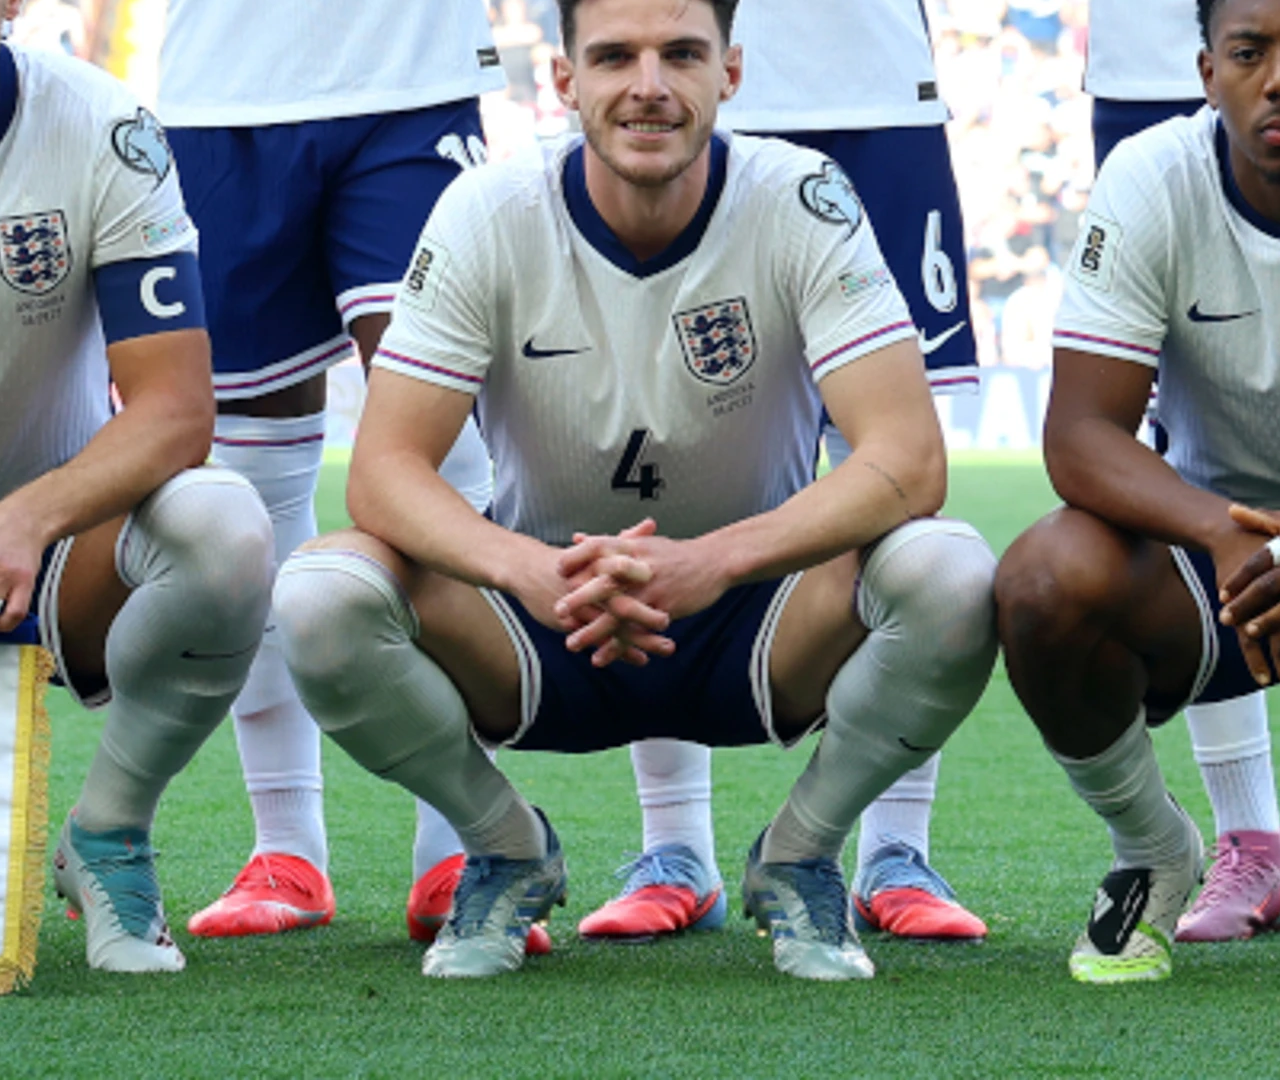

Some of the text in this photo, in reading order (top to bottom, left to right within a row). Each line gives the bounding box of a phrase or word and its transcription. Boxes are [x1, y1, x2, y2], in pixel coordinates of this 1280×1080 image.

[139, 266, 186, 319] C
[922, 209, 958, 313] 6
[611, 429, 664, 501] 4
